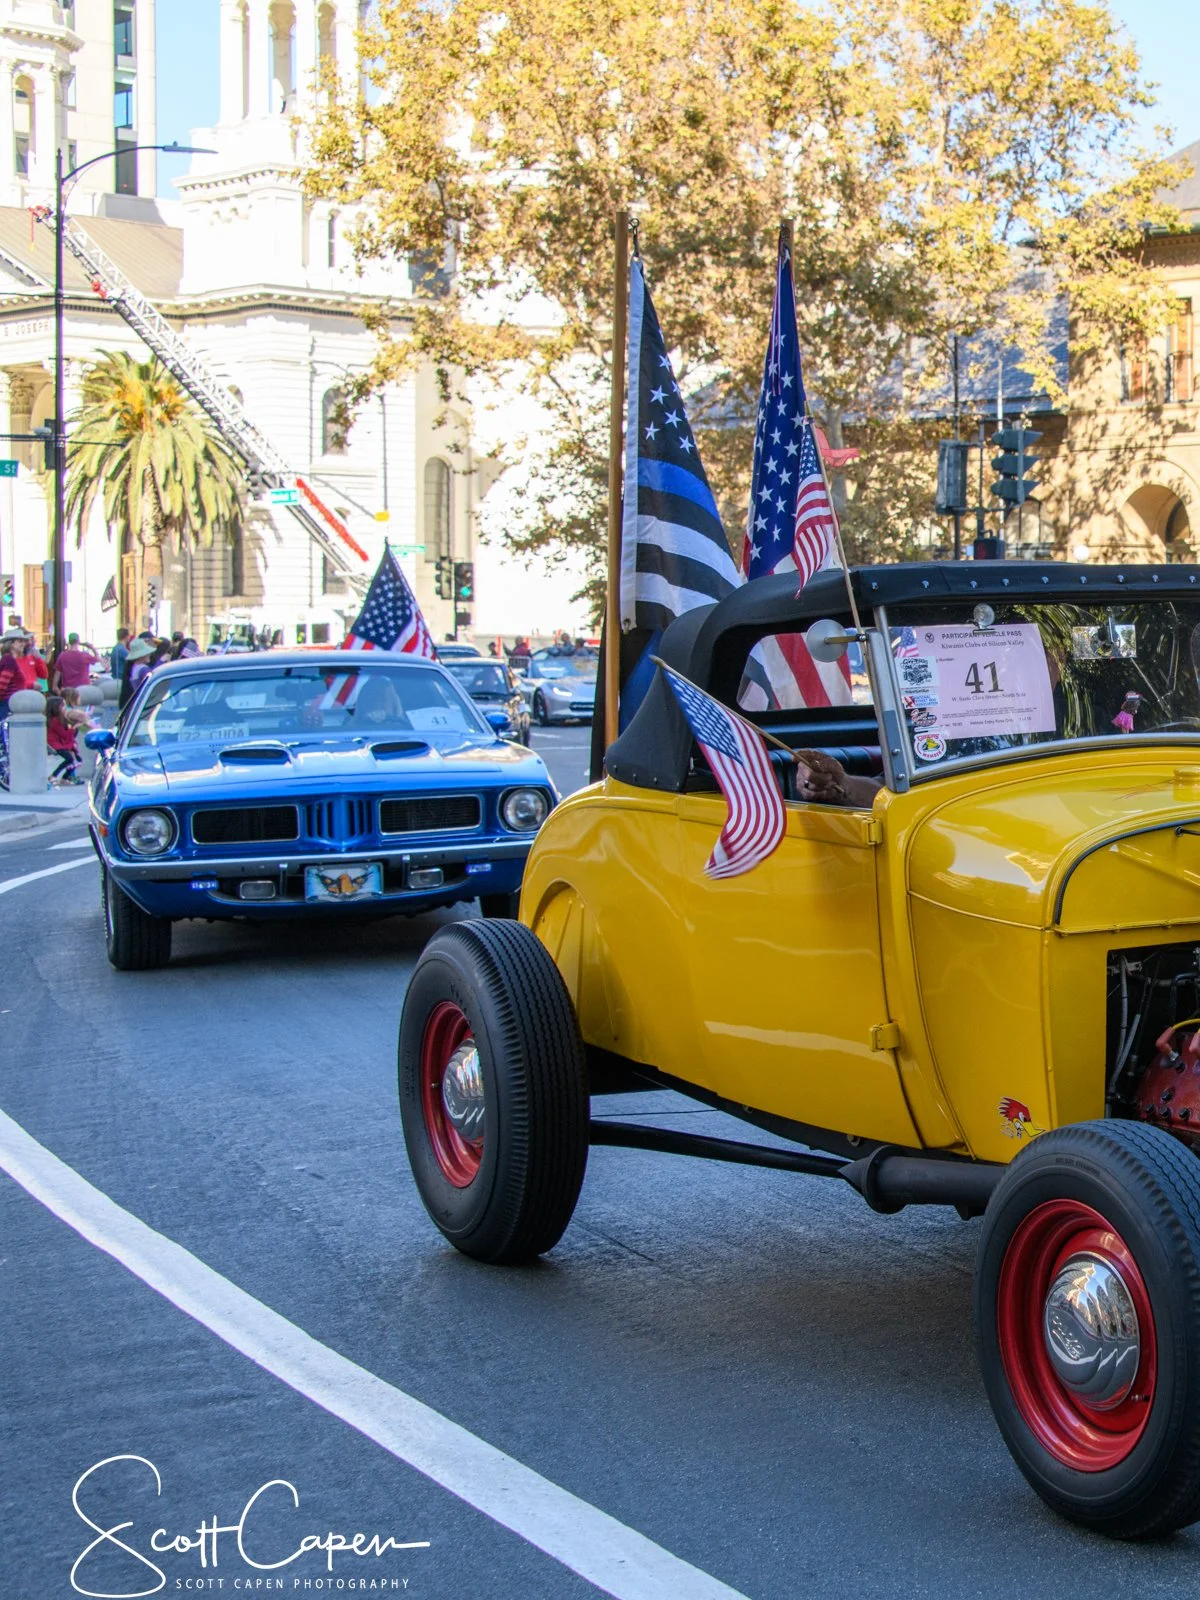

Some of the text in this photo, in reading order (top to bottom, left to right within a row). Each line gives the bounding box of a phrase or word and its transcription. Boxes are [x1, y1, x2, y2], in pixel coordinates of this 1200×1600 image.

[4, 463, 17, 473] St
[964, 661, 1004, 694] 41
[431, 716, 448, 725] 41
